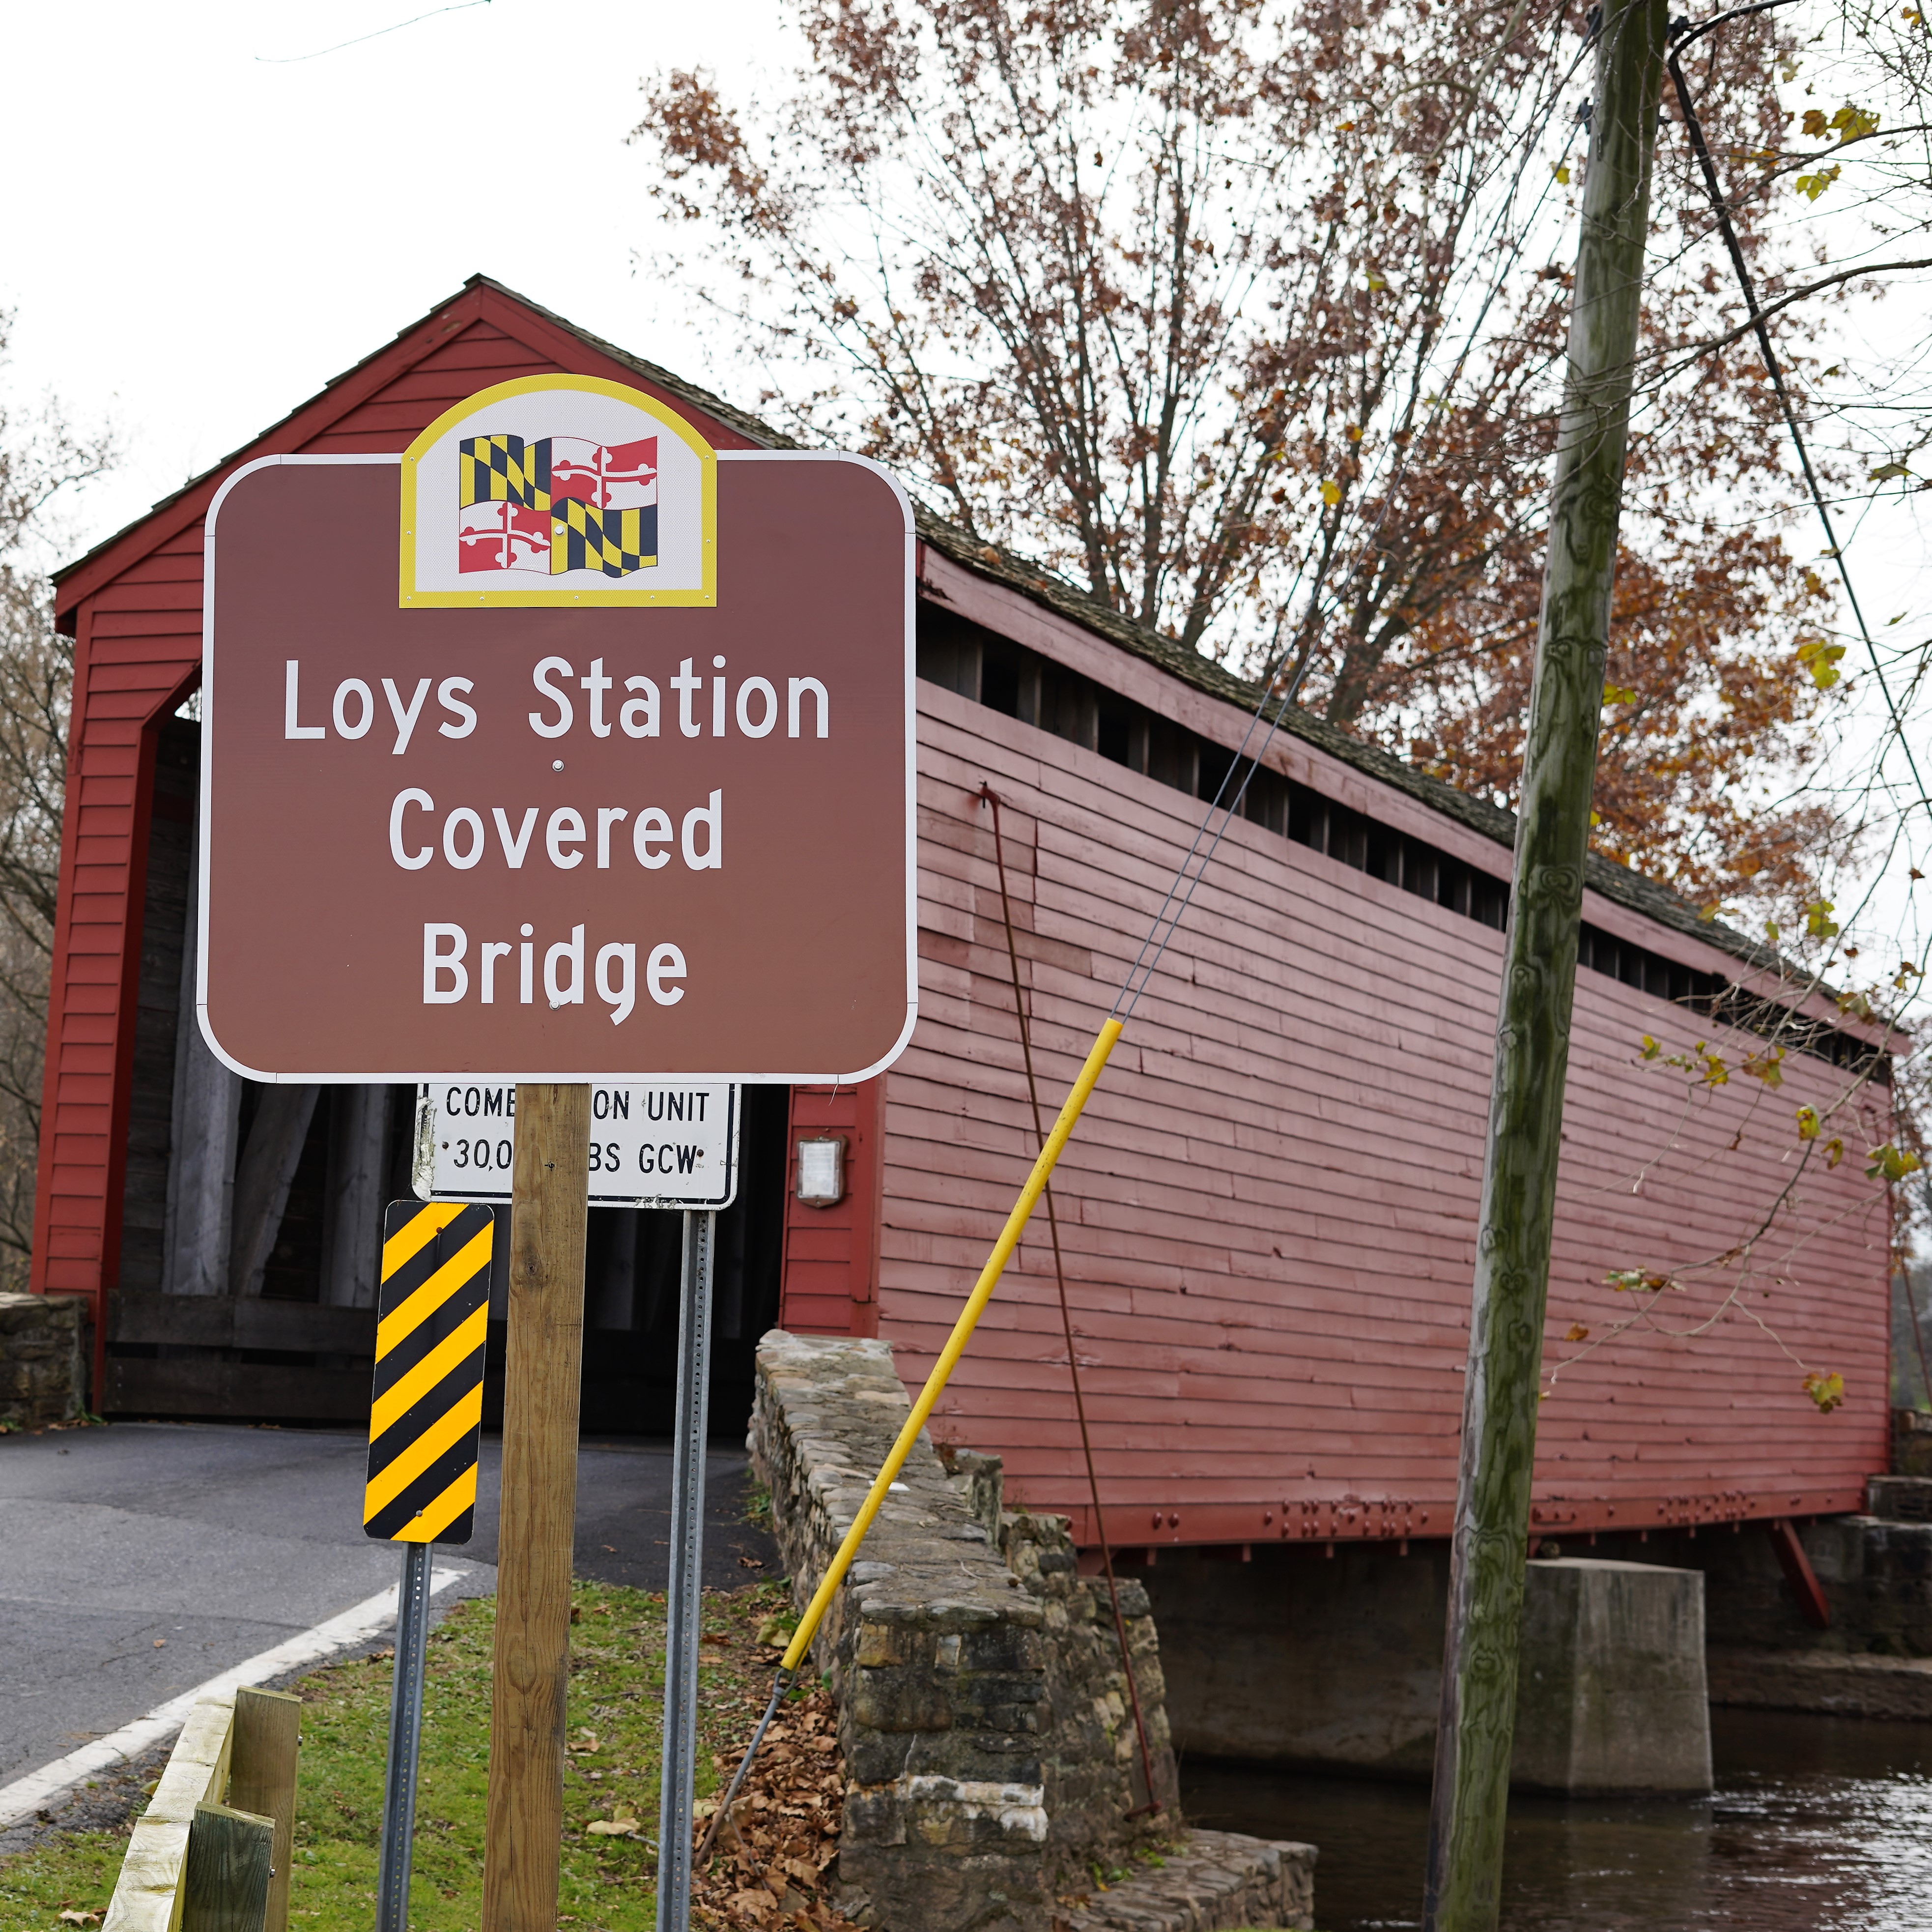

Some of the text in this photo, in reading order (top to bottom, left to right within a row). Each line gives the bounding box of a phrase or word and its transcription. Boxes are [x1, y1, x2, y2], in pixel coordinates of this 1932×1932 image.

[285, 655, 828, 754] Loys Station
[390, 788, 722, 870] Covered
[424, 923, 687, 1025] Bridge
[648, 1092, 710, 1122] UNIT
[589, 1143, 620, 1172] BS
[639, 1144, 697, 1174] GCW
